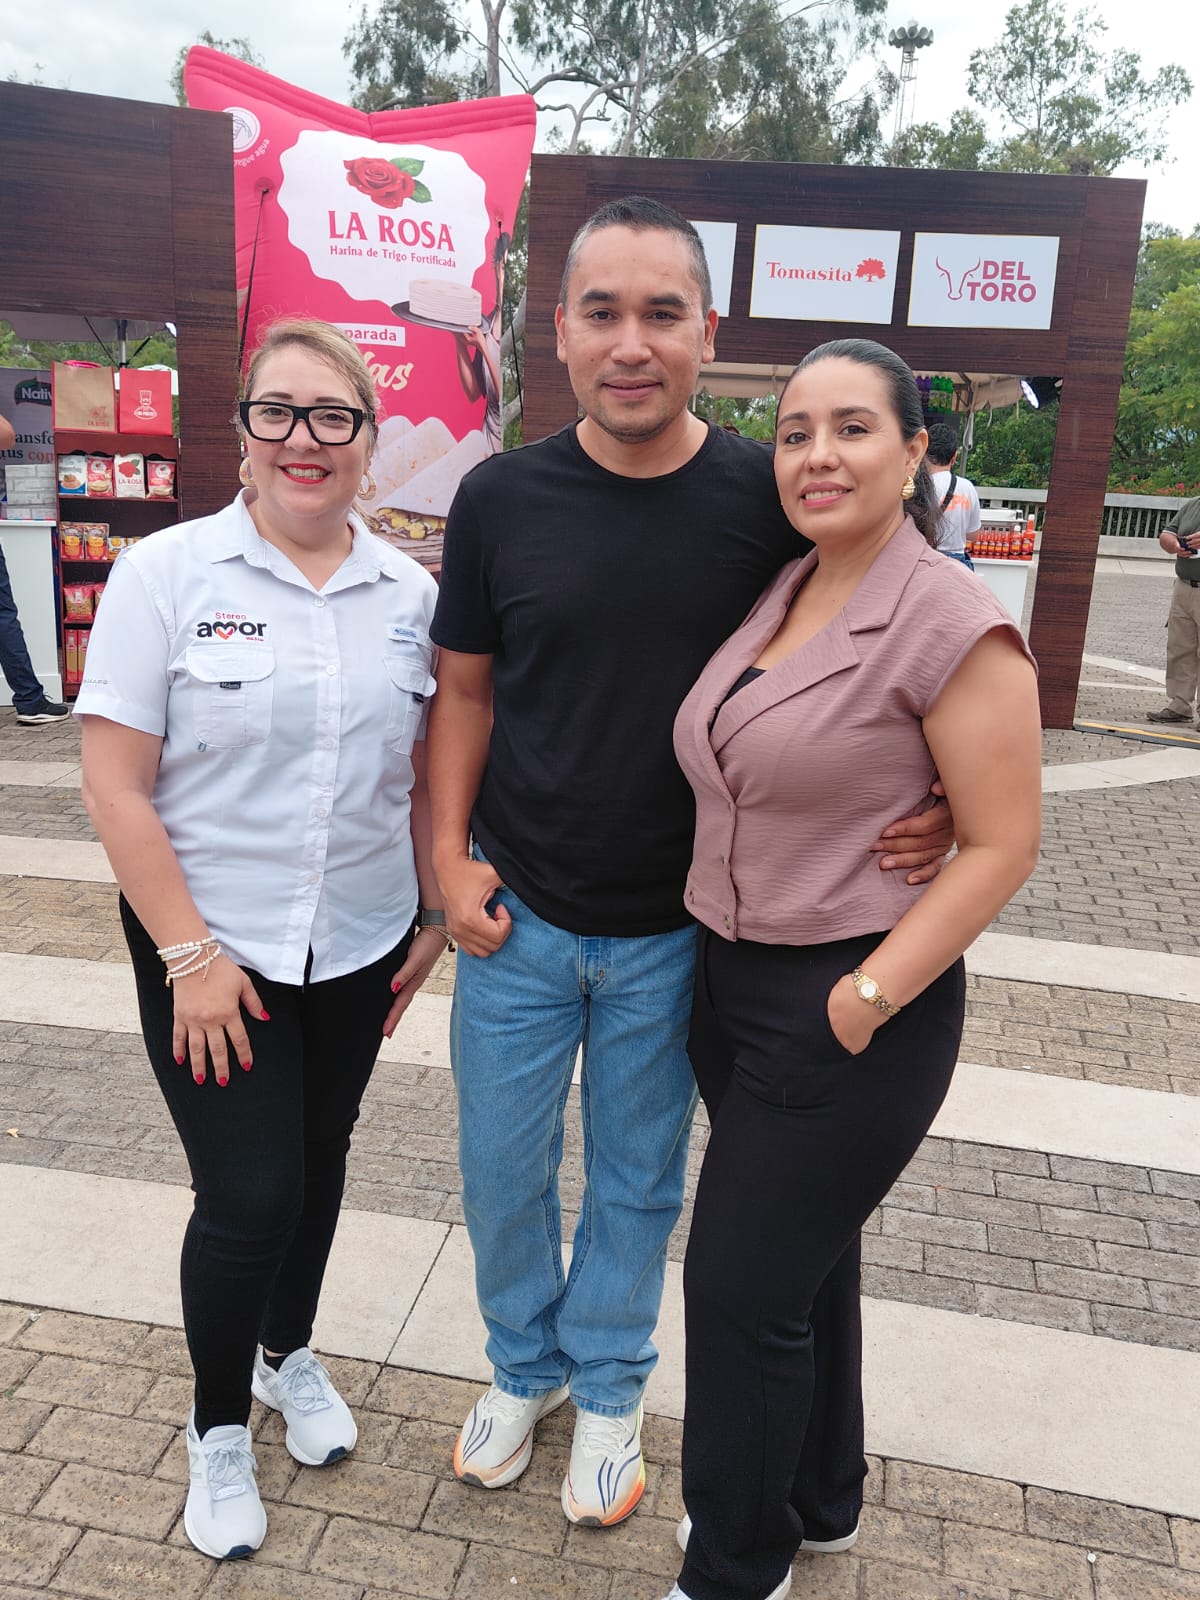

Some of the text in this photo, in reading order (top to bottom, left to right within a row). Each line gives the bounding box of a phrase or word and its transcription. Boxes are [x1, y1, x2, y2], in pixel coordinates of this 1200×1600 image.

[328, 210, 455, 252] LA ROSA
[330, 245, 456, 268] Harina de Trigo Fortificada
[766, 261, 853, 282] Tomasita
[982, 260, 1031, 281] DEL
[966, 282, 1037, 303] TORO
[215, 612, 247, 620] Stereo
[196, 621, 267, 640] amor
